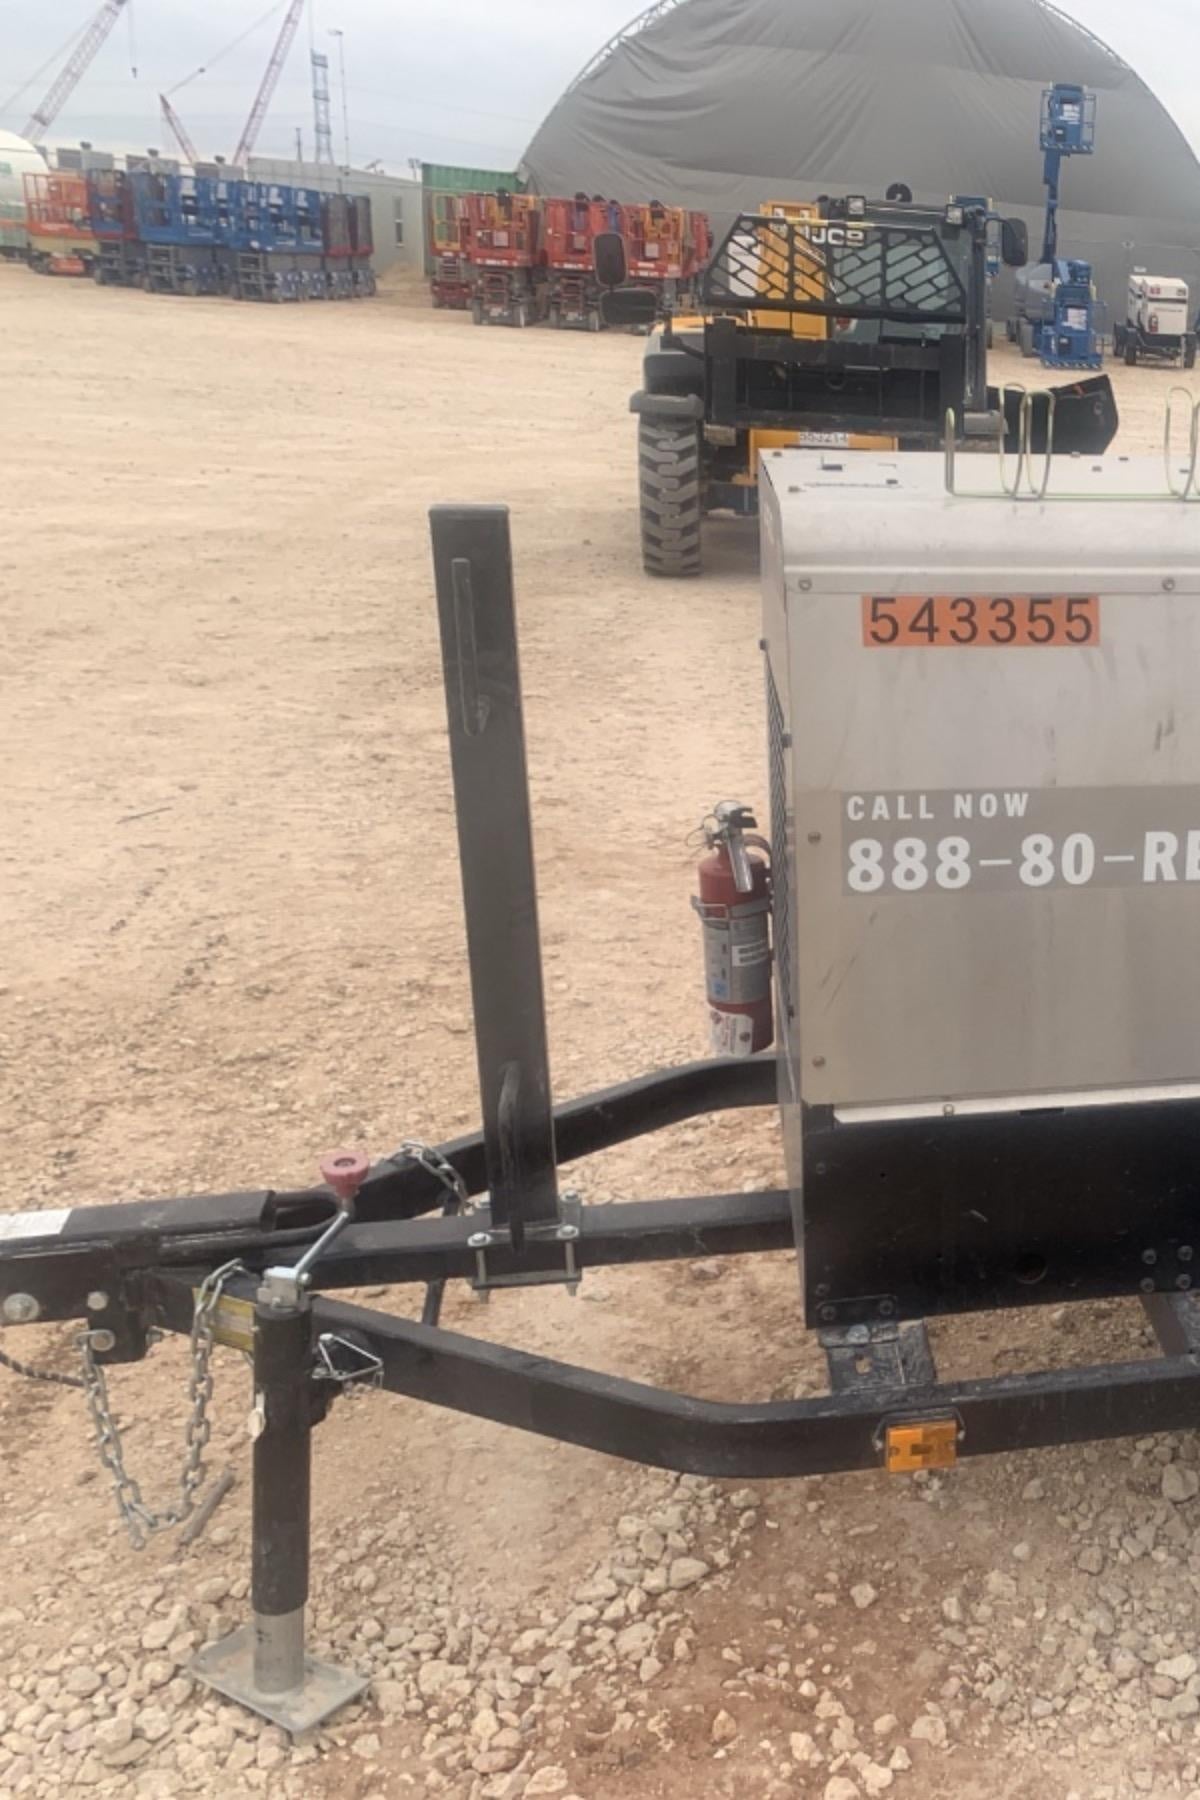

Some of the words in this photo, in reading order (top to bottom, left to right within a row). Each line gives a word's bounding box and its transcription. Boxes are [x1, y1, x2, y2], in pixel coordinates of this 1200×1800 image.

[869, 597, 1093, 643] 543355
[847, 794, 935, 821] CALL
[953, 792, 1029, 819] NOW
